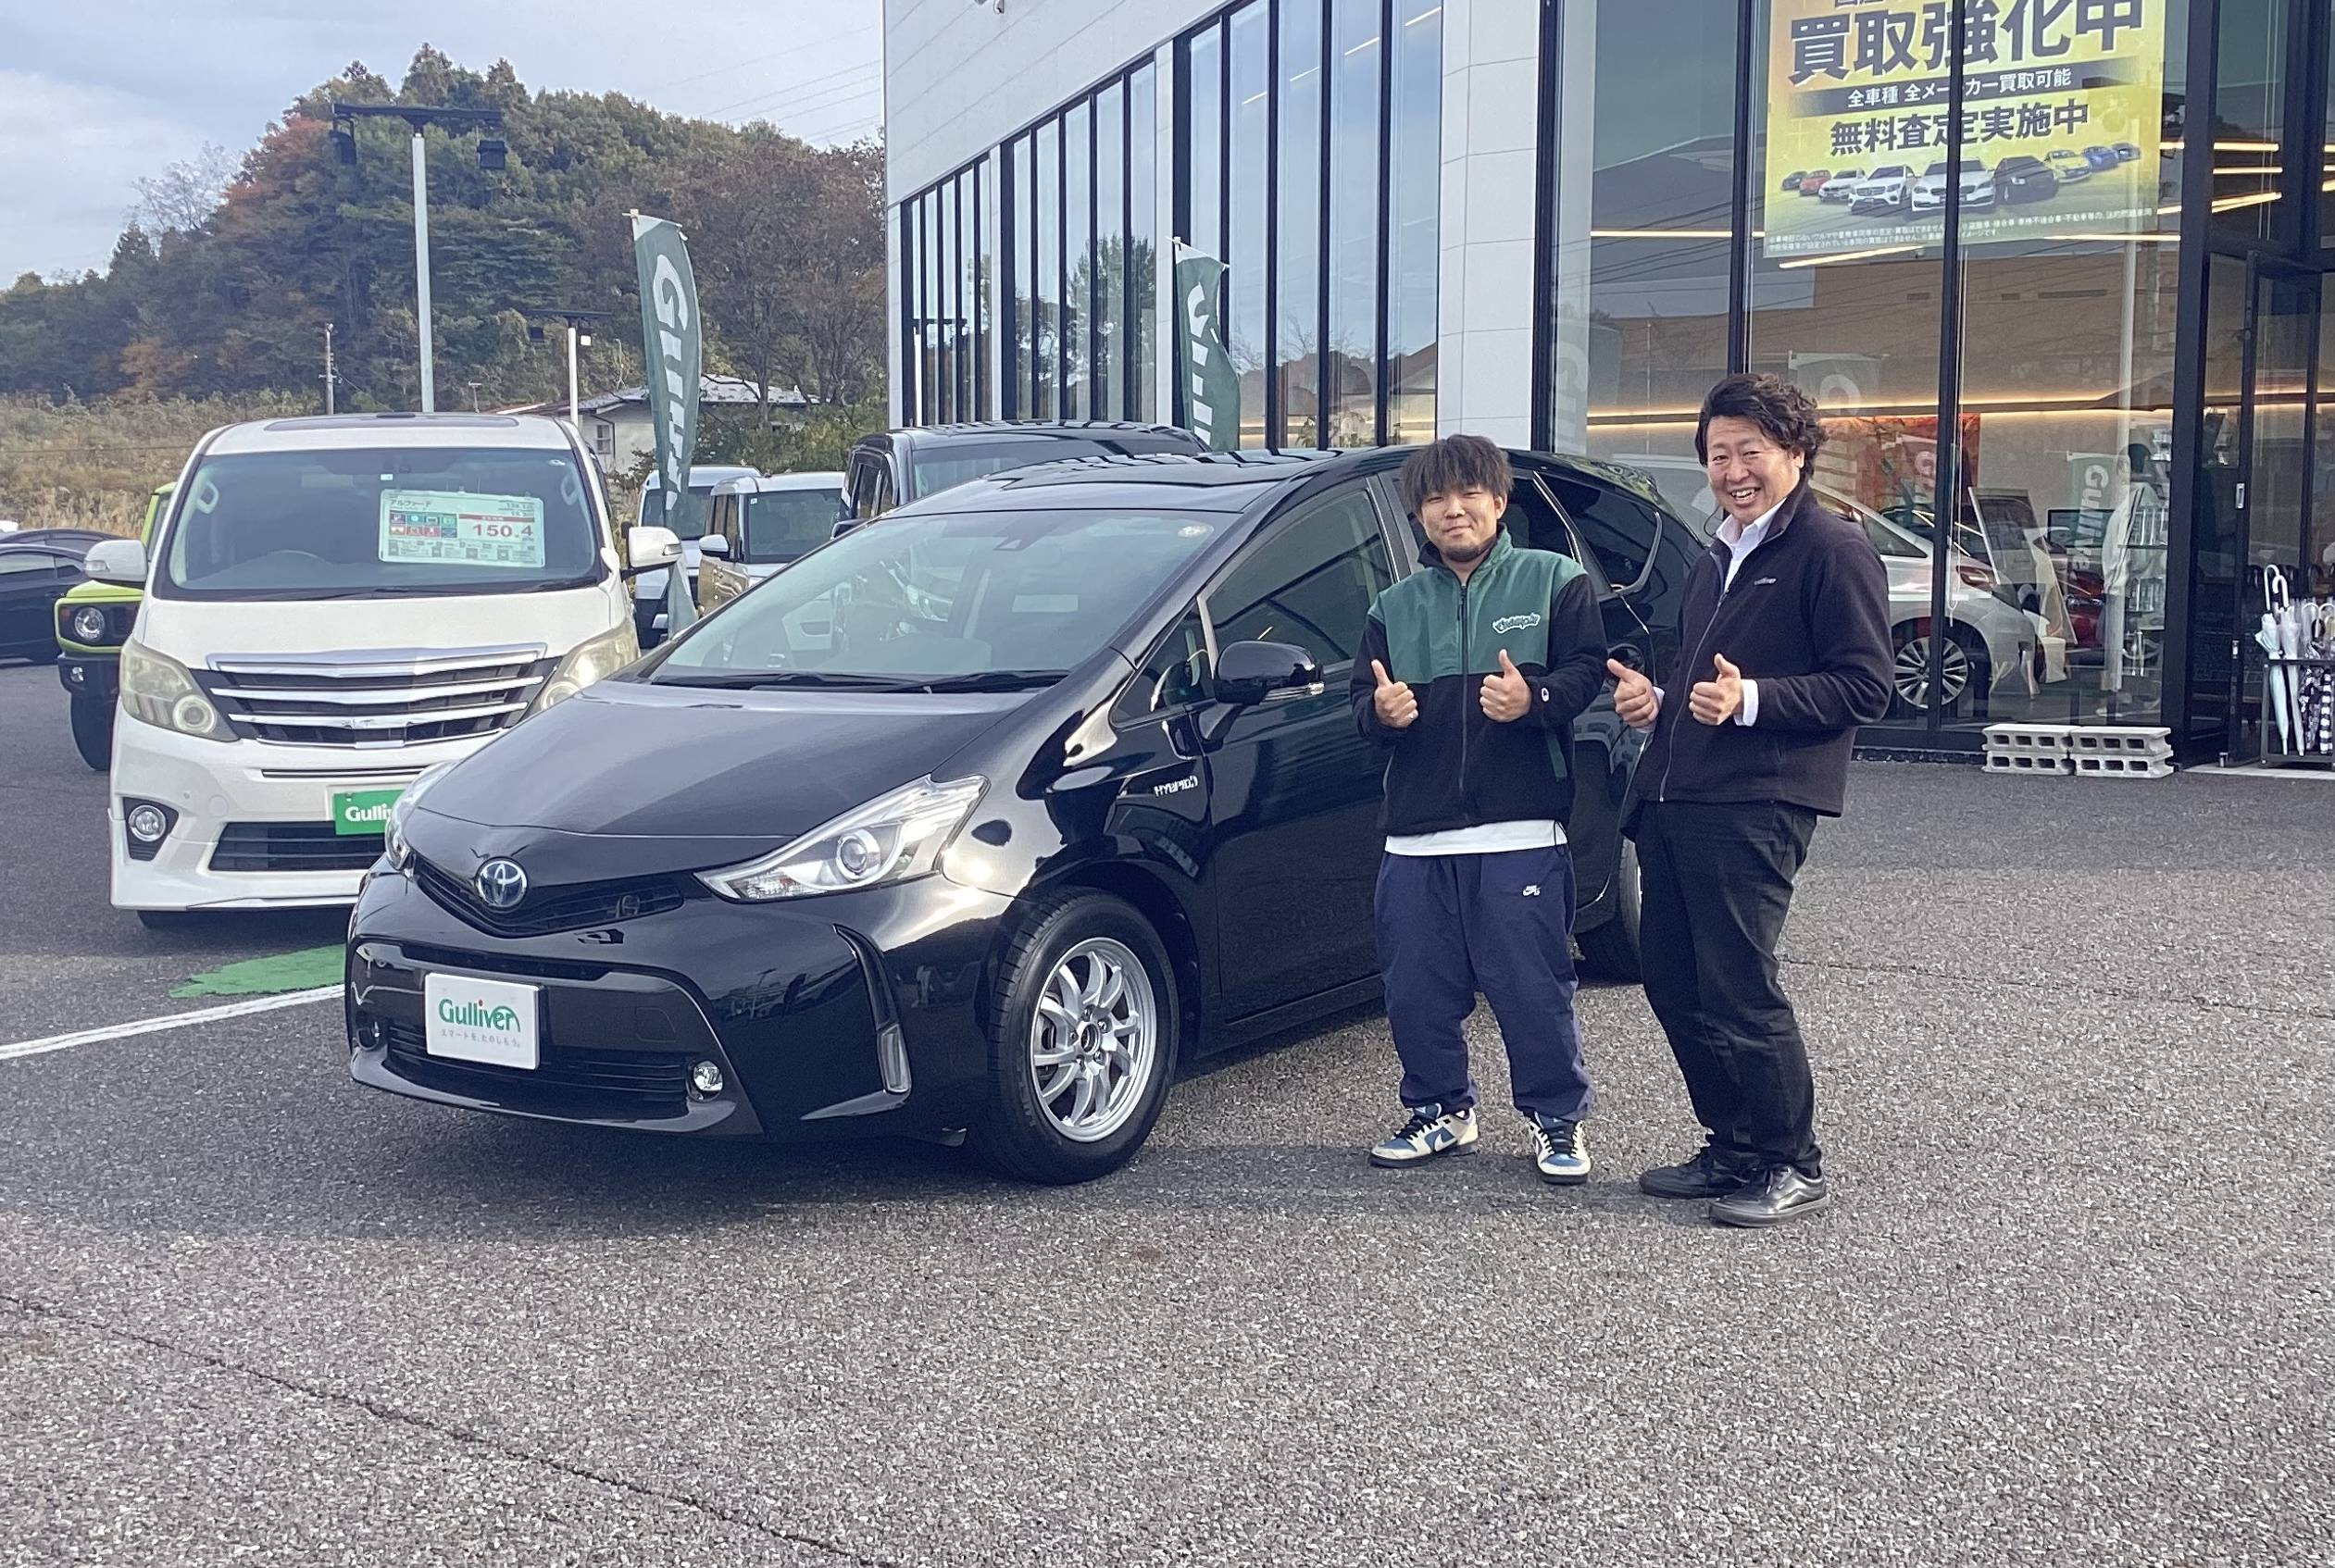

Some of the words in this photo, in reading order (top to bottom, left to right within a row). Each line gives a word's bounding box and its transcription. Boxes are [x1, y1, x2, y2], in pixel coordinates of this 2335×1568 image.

[1788, 0, 2141, 85] 買取強化中
[1848, 85, 1897, 107] 全車種
[1829, 97, 2090, 156] 無料査定実施中
[473, 524, 533, 538] 150.4
[439, 999, 520, 1033] Gulliver
